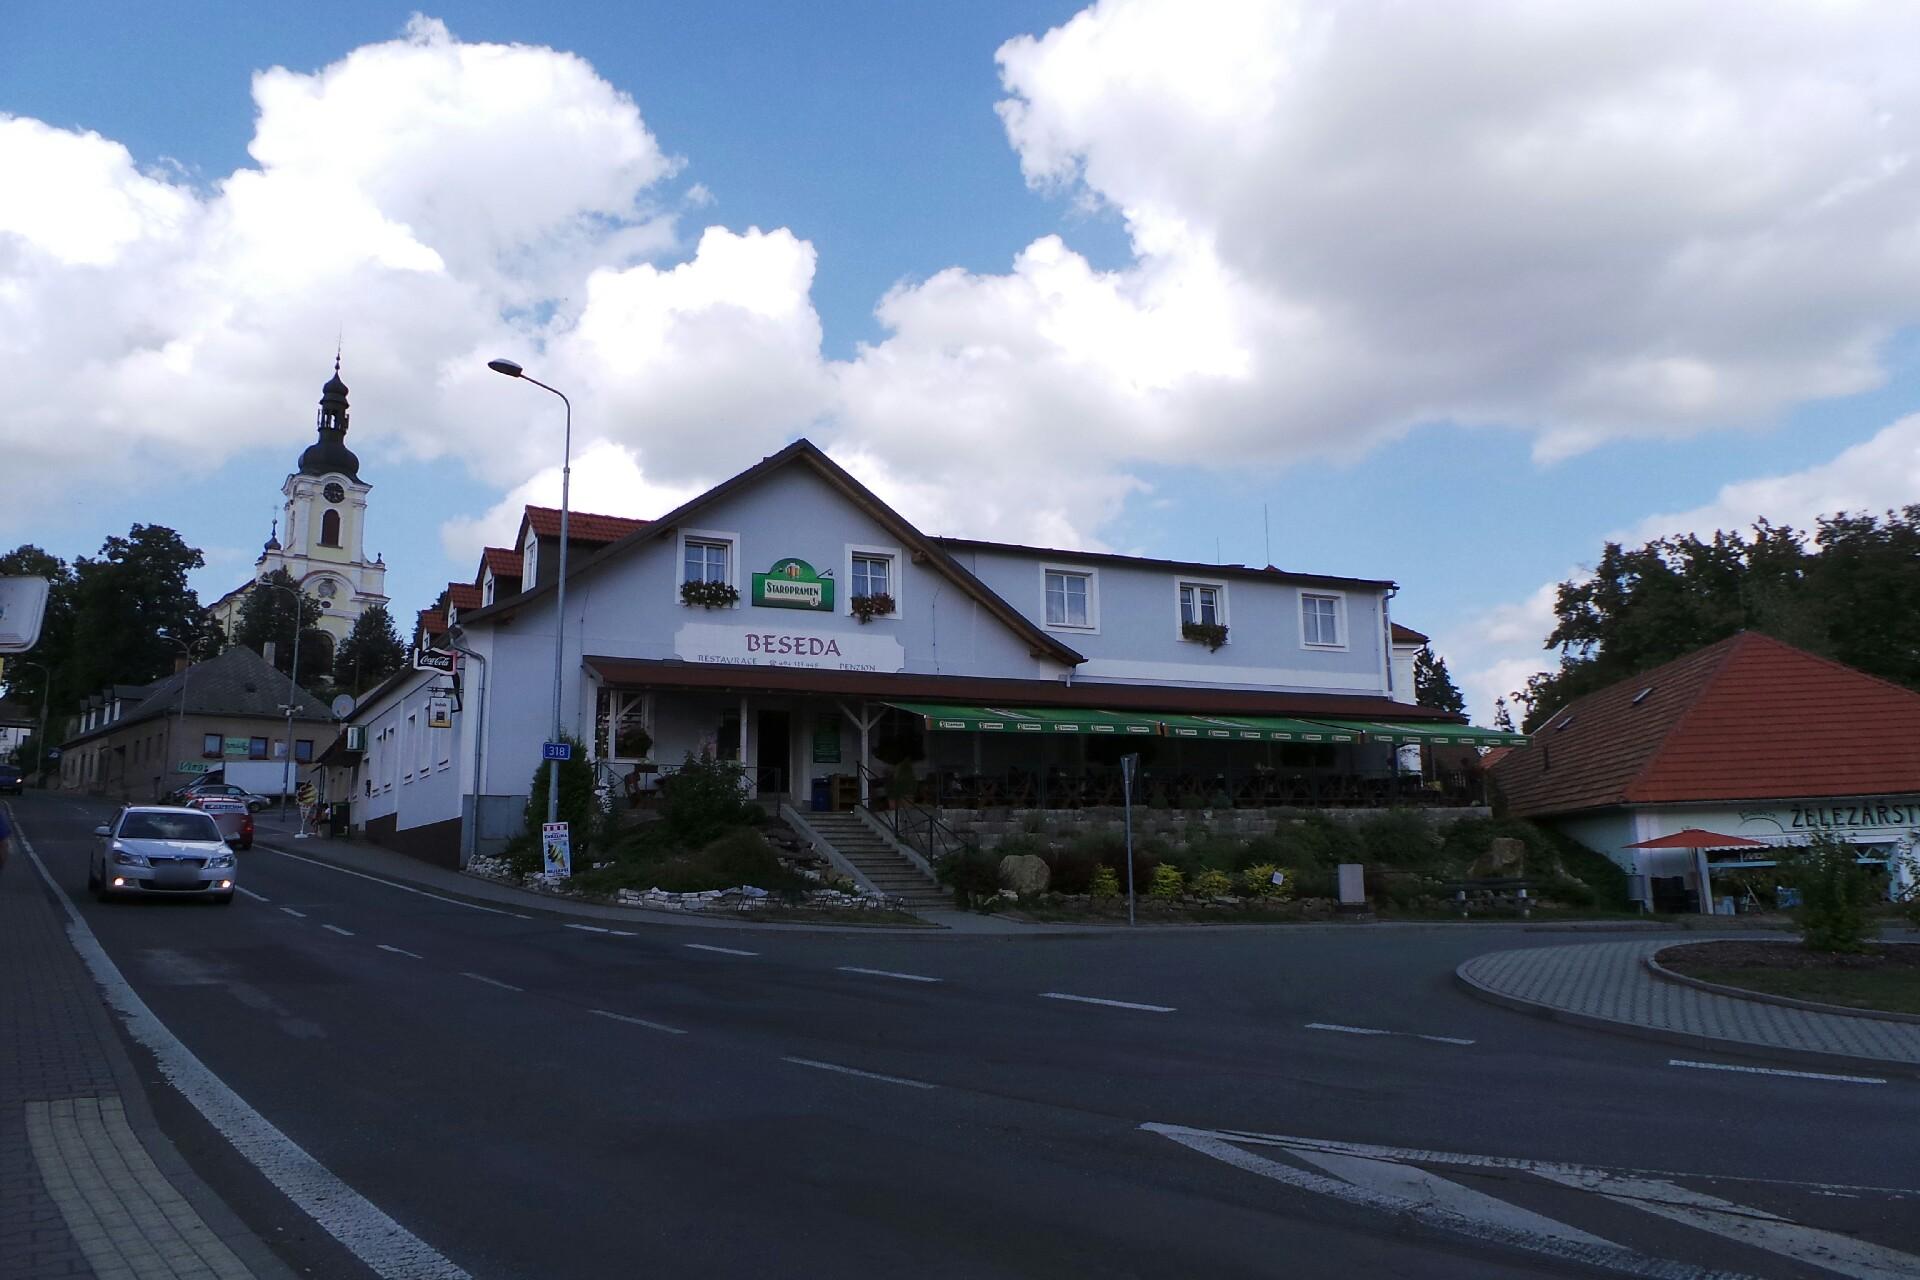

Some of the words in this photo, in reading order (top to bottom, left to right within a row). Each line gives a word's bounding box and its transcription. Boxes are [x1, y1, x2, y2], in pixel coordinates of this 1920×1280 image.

[745, 633, 842, 656] BESEDA
[548, 745, 565, 757] 318
[1790, 801, 1920, 828] ŽELEZÁŘST
